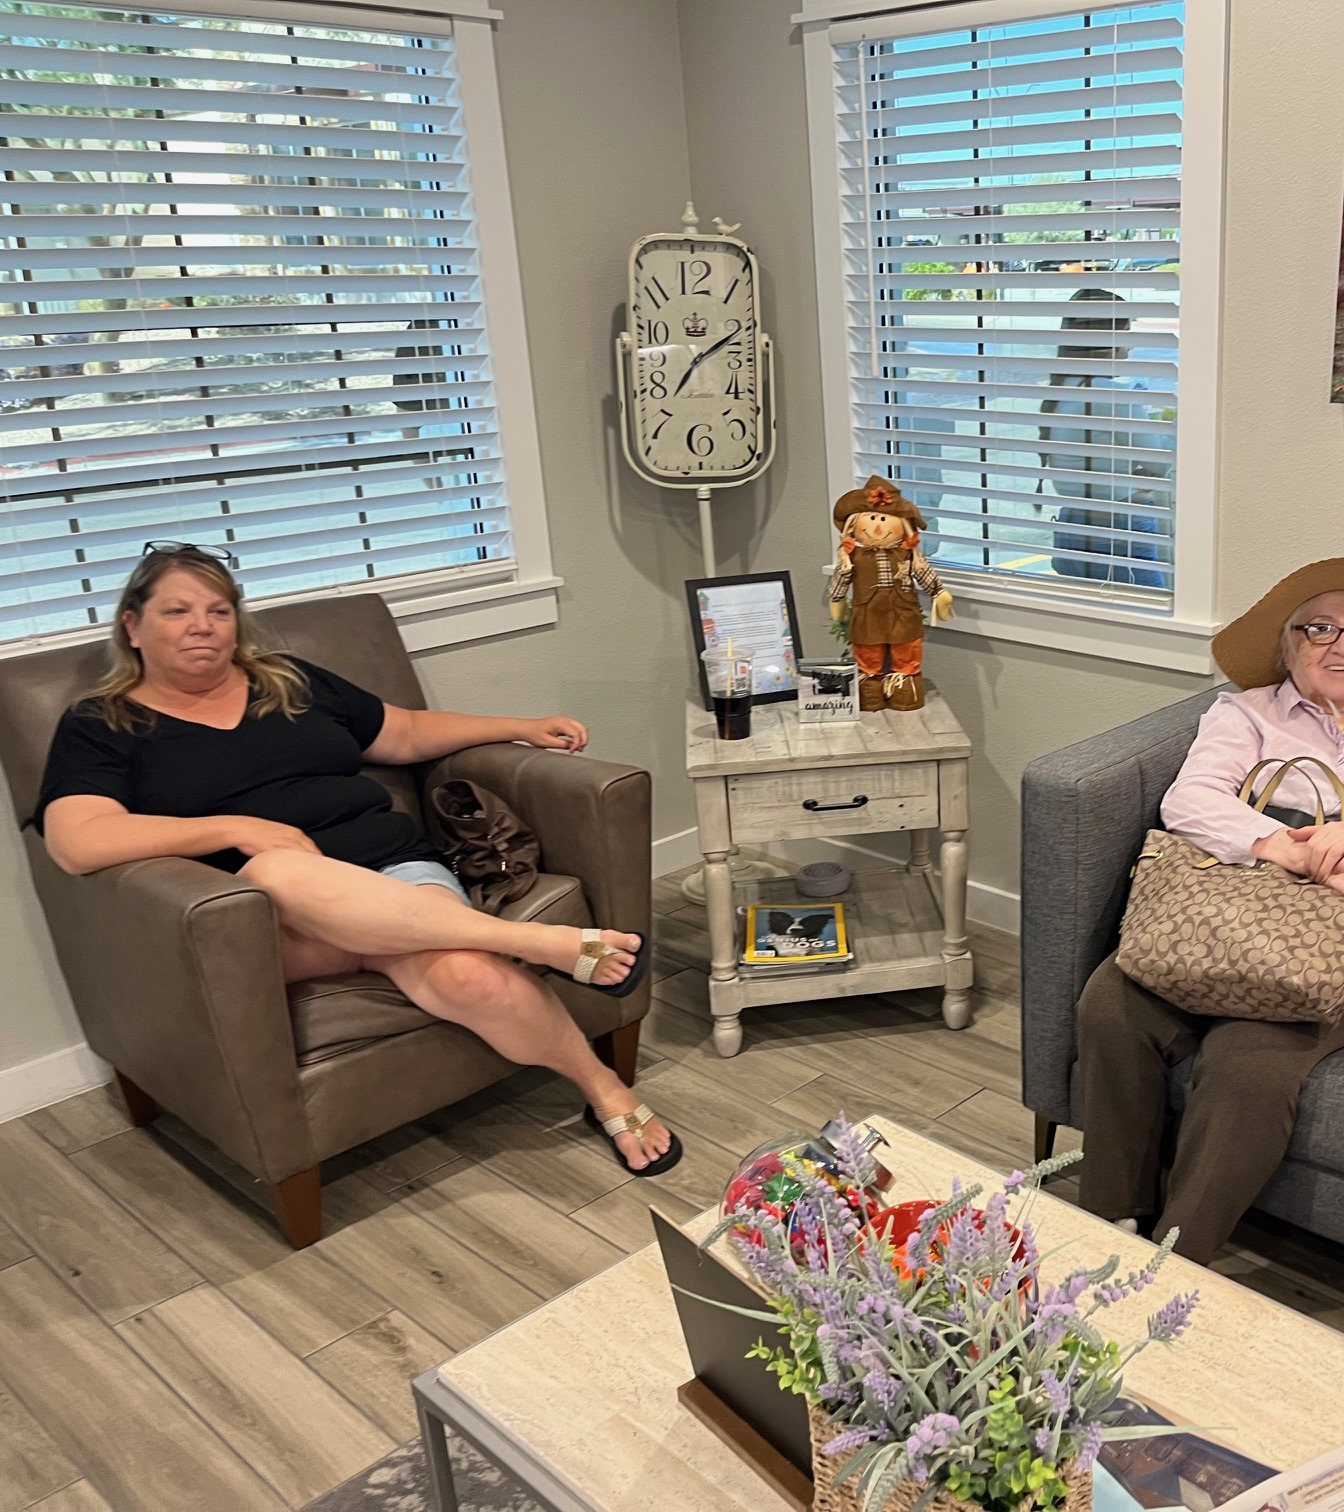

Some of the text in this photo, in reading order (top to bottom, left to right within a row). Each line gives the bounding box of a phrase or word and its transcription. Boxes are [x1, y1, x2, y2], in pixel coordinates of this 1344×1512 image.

[644, 276, 671, 310] 11
[678, 260, 711, 296] 12
[723, 279, 739, 304] 1
[647, 319, 670, 345] 10
[649, 351, 667, 368] 9
[727, 351, 743, 371] 3
[649, 370, 668, 400] 8
[725, 371, 746, 401] 4
[651, 408, 674, 440] 7
[722, 408, 747, 441] 5
[686, 424, 714, 457] 6
[805, 700, 853, 715] amazing
[782, 940, 837, 948] DOGS
